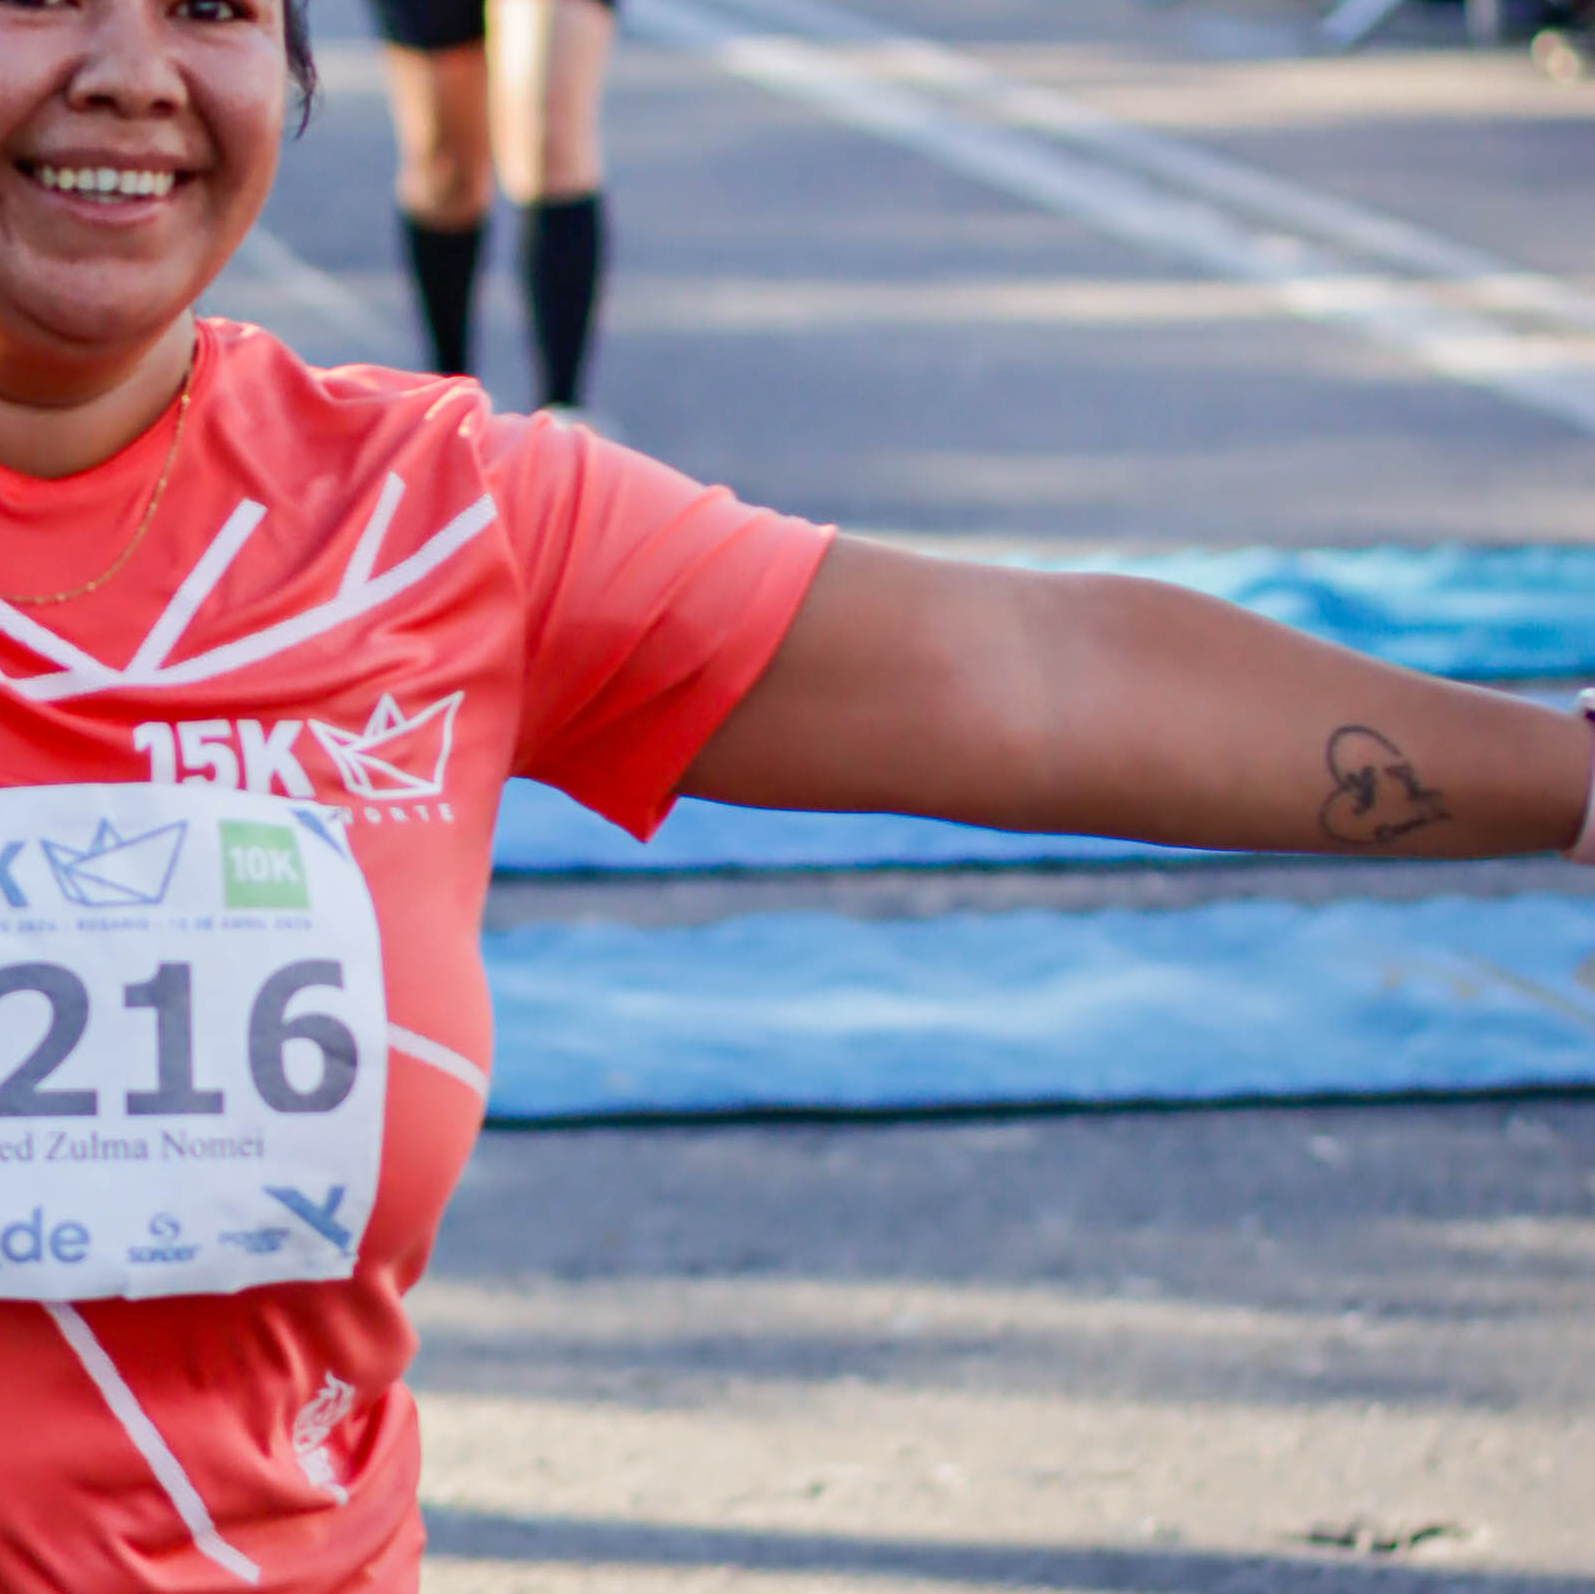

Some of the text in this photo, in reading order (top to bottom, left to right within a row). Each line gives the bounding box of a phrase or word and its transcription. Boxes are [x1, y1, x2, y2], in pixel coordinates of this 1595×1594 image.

[133, 718, 317, 799] 15K
[229, 845, 298, 882] 10K
[45, 1130, 150, 1161] Zulma
